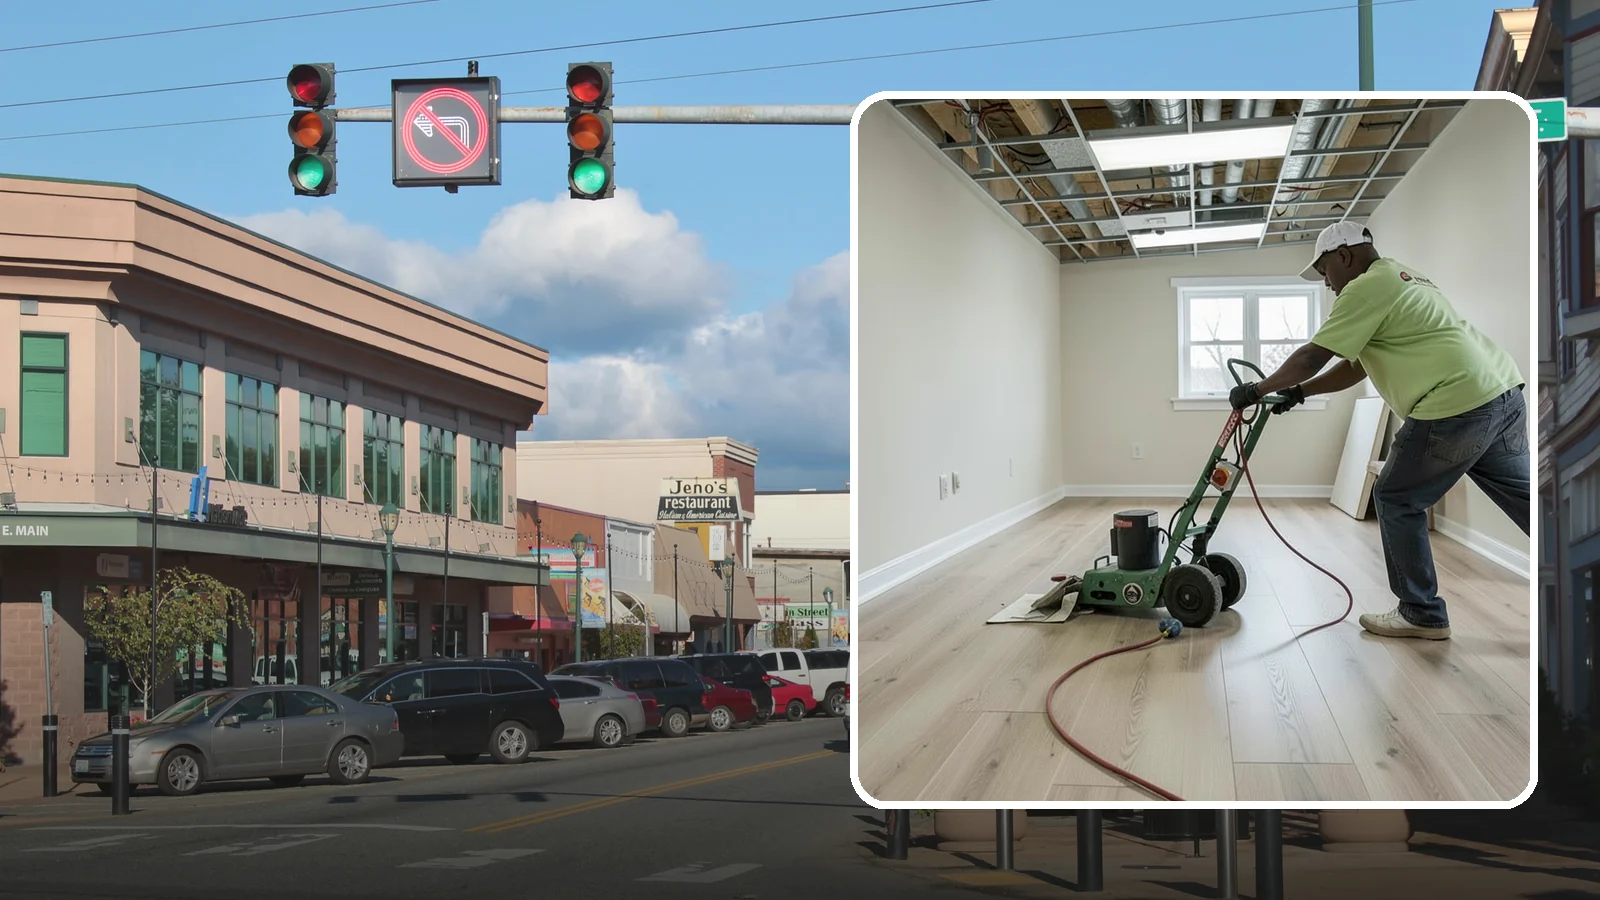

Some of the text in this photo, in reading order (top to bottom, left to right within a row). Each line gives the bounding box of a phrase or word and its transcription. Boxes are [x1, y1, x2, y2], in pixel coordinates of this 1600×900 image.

[670, 480, 727, 494] Jeno's
[665, 496, 731, 509] restaurant
[658, 510, 681, 519] Italian
[686, 510, 714, 519] American
[715, 510, 737, 519] Cuisine
[2, 525, 49, 536] E. MAIN
[797, 607, 828, 617] Street
[791, 619, 824, 627] lass
